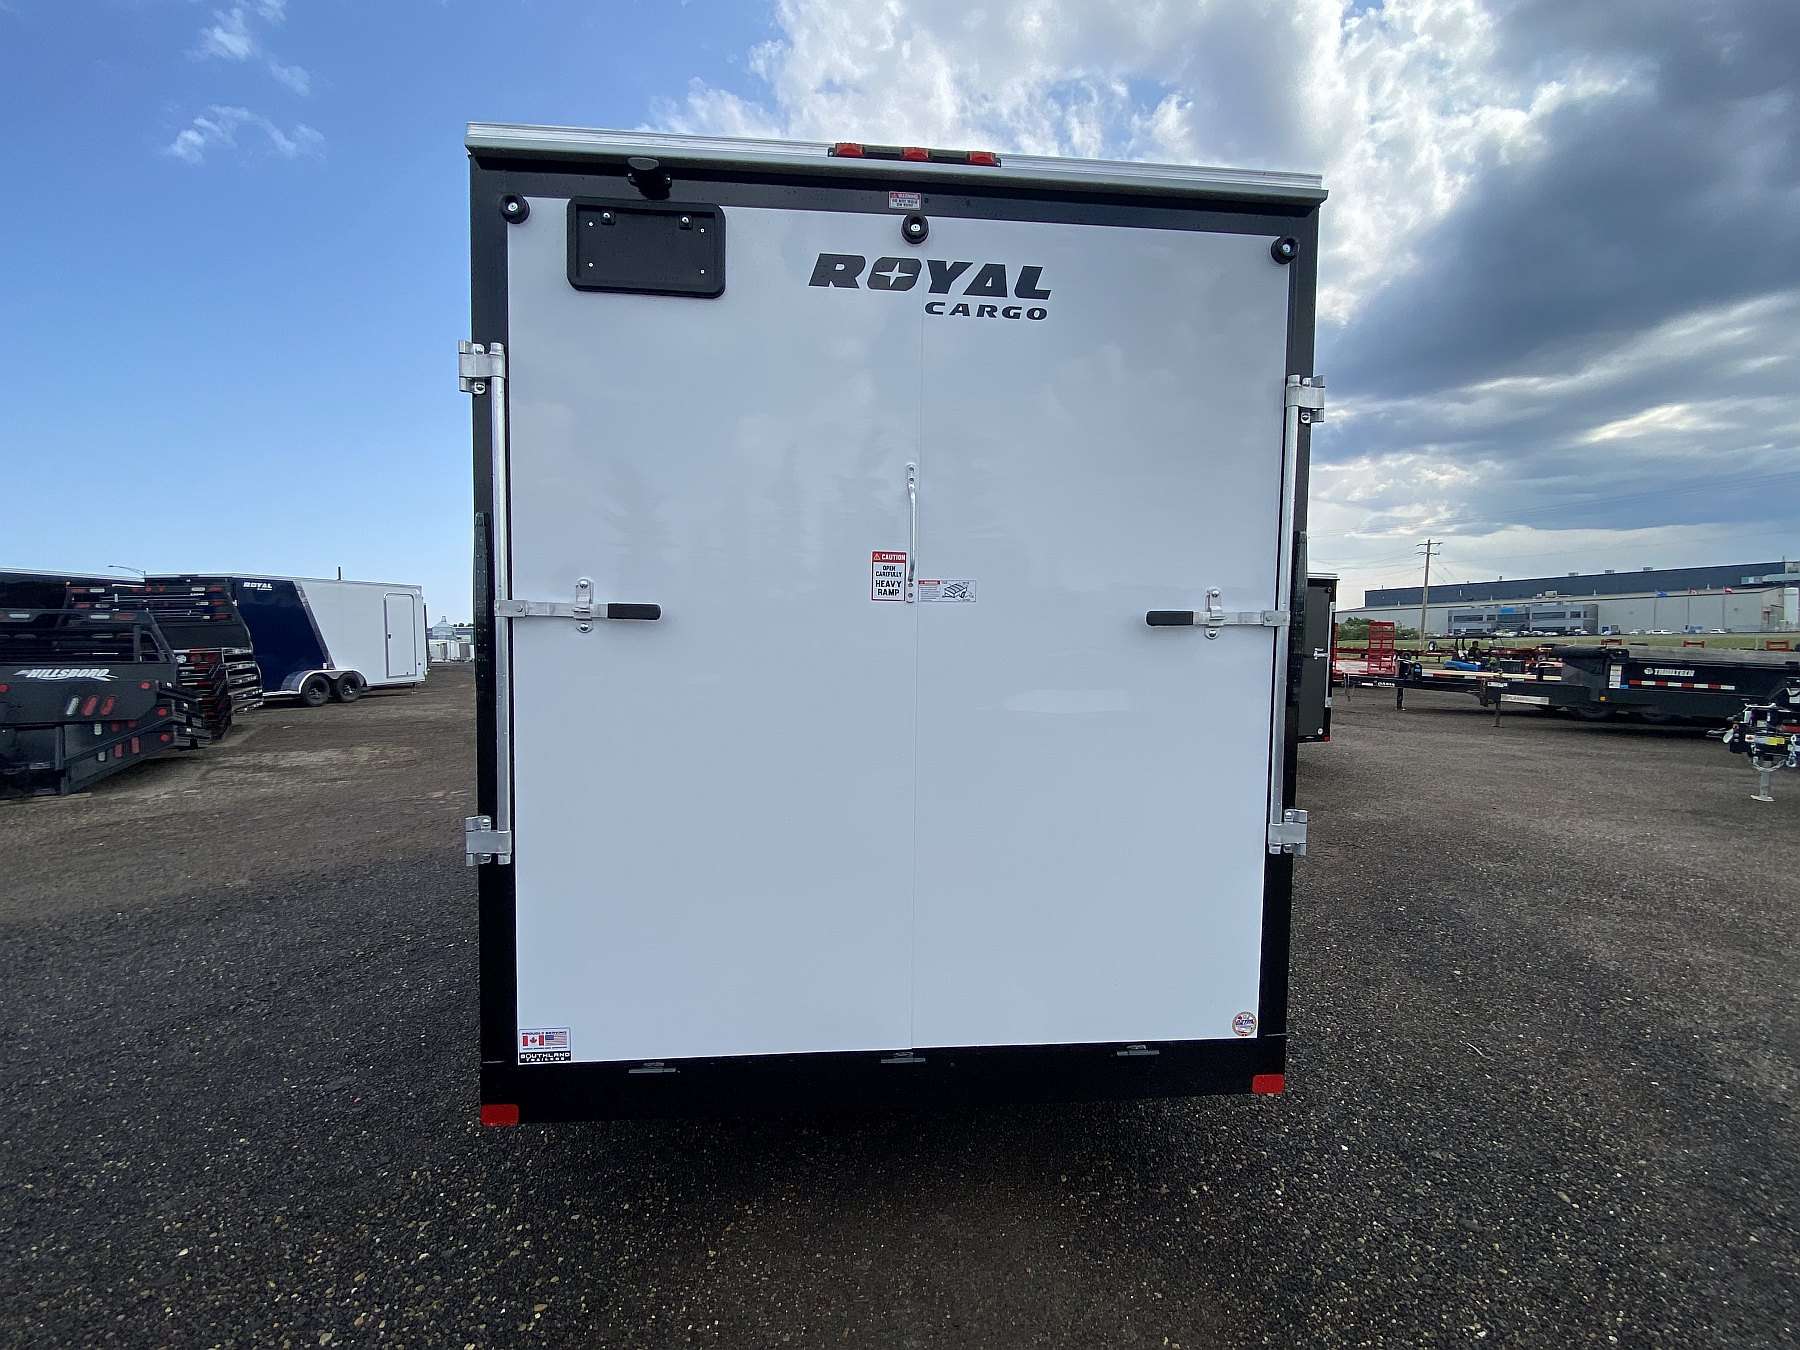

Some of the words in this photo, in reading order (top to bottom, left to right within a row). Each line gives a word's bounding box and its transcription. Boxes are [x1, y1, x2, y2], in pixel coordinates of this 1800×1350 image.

[808, 253, 1052, 300] ROYAL
[924, 301, 1048, 321] CARGO
[881, 553, 906, 561] CAUTION
[243, 581, 273, 589] ROYAL
[875, 580, 902, 588] HEAVY
[877, 588, 900, 597] RAMP
[26, 668, 111, 679] HILLSBORO
